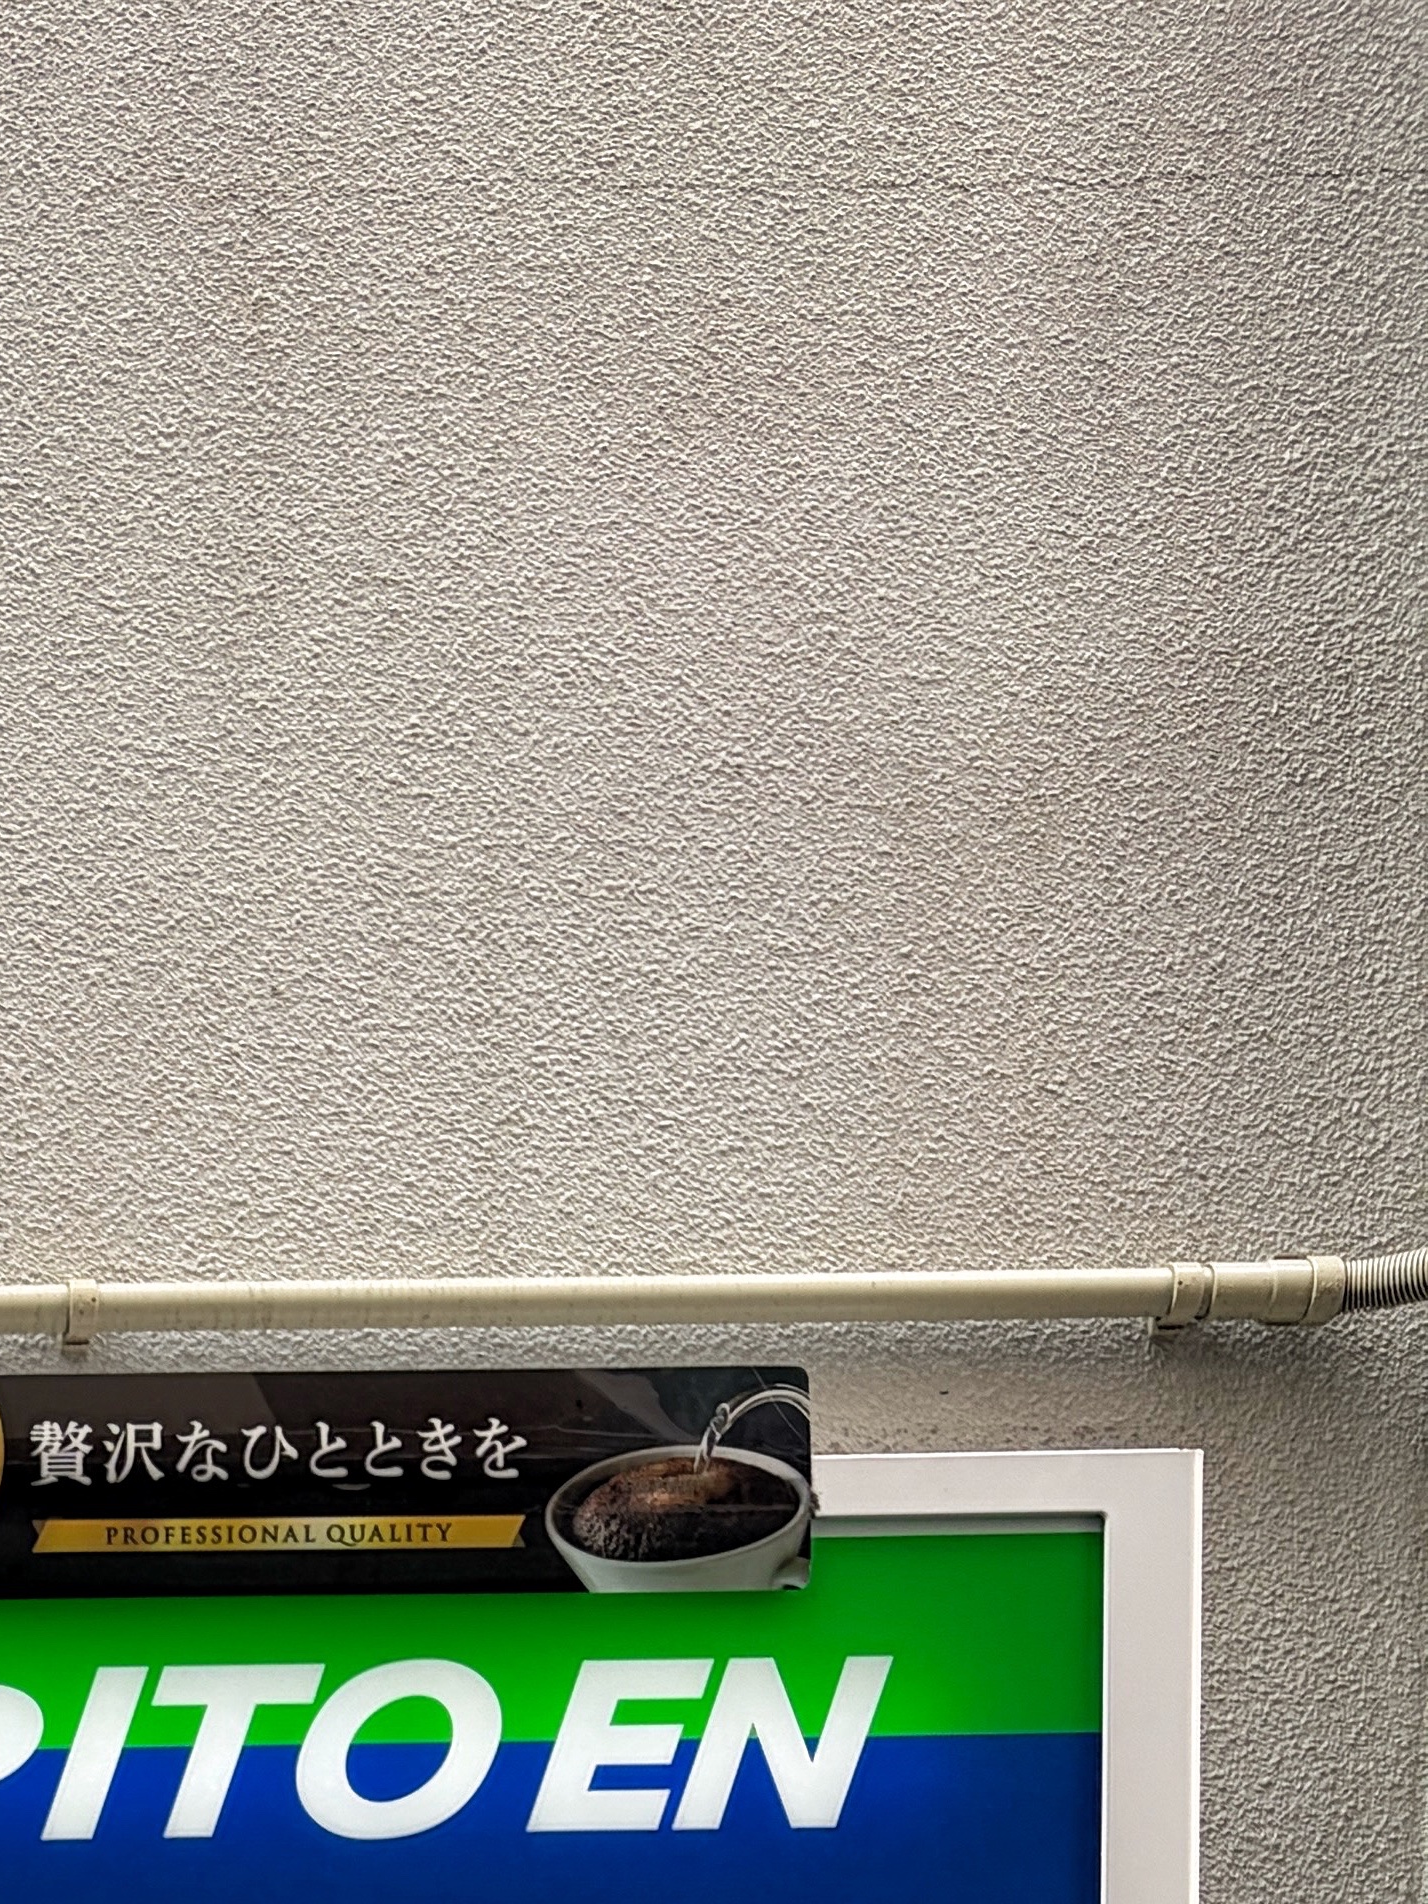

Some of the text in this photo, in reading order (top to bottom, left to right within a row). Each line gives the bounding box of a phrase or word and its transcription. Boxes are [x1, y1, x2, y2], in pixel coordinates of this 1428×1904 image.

[29, 1418, 527, 1487] 贅沢なひとときを
[105, 1522, 452, 1547] PROFESSIONAL QUALITY
[40, 1654, 893, 1840] ITO EN
